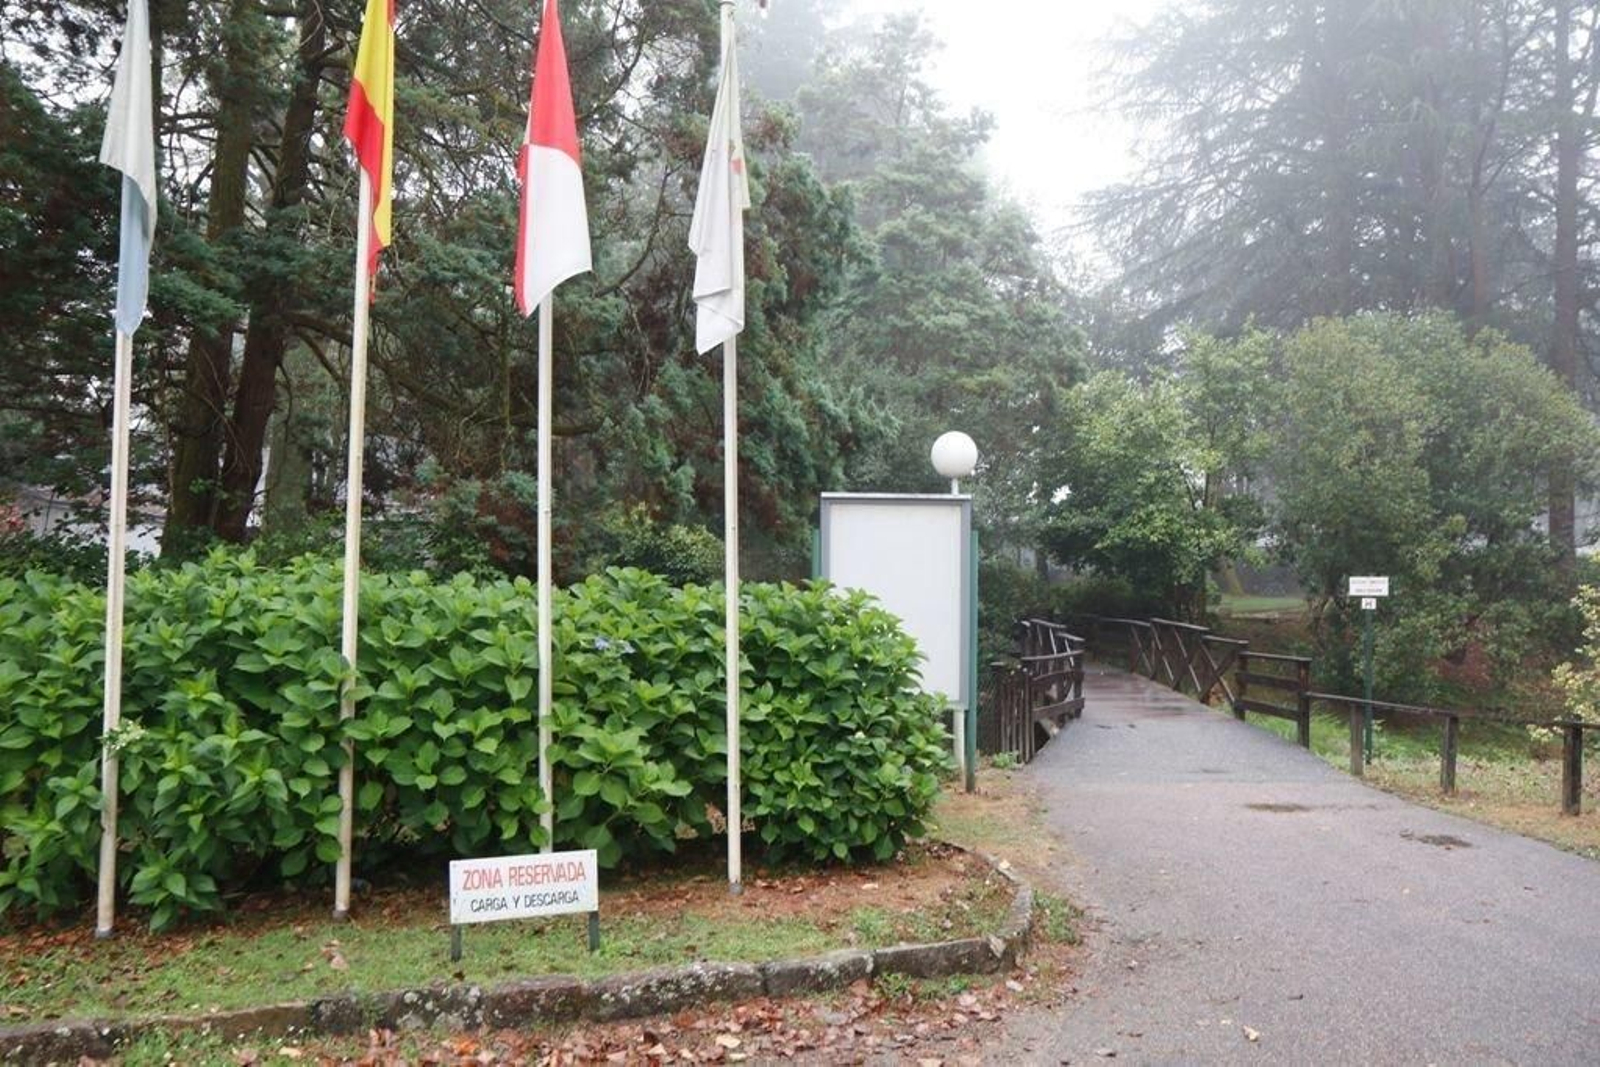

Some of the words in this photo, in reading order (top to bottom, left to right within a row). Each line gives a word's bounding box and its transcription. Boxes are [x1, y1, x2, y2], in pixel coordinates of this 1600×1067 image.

[462, 867, 503, 891] ZONA
[508, 861, 587, 887] RESERVADA
[470, 895, 508, 913] CARGA
[512, 895, 521, 909] Y
[524, 890, 579, 908] DESCARGA
